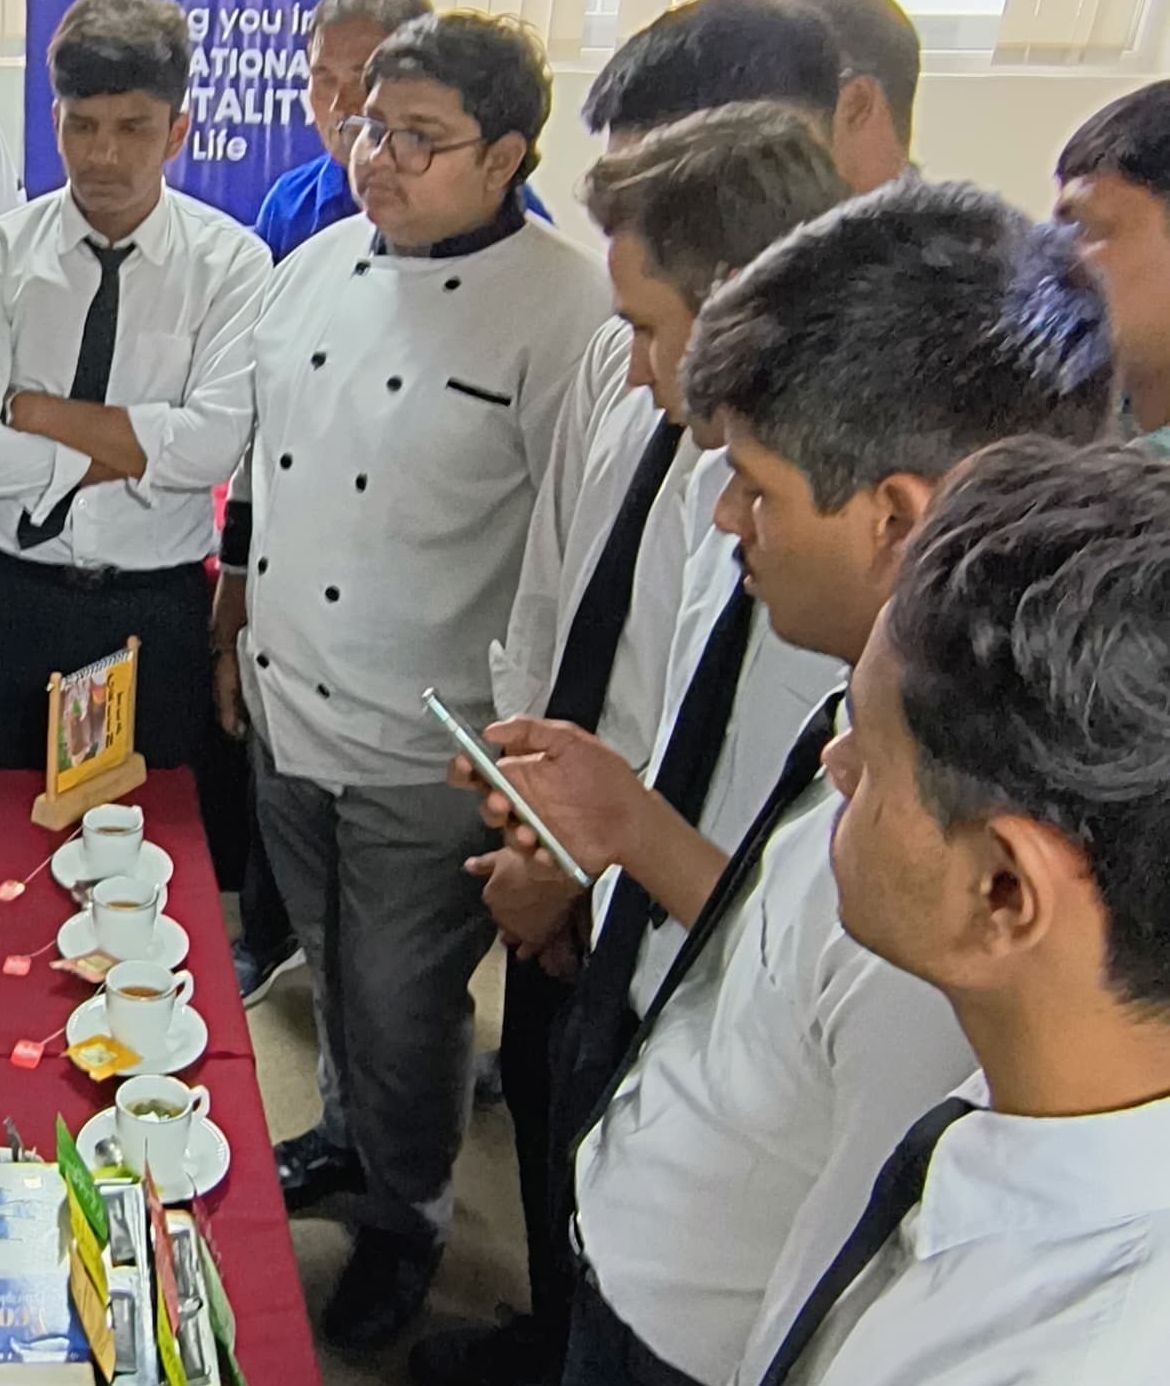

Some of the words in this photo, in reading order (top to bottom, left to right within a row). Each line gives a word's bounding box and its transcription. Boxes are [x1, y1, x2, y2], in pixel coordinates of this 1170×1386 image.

[187, 7, 210, 42] g
[219, 7, 283, 42] you
[188, 45, 312, 80] ATIONA
[192, 128, 248, 162] Life
